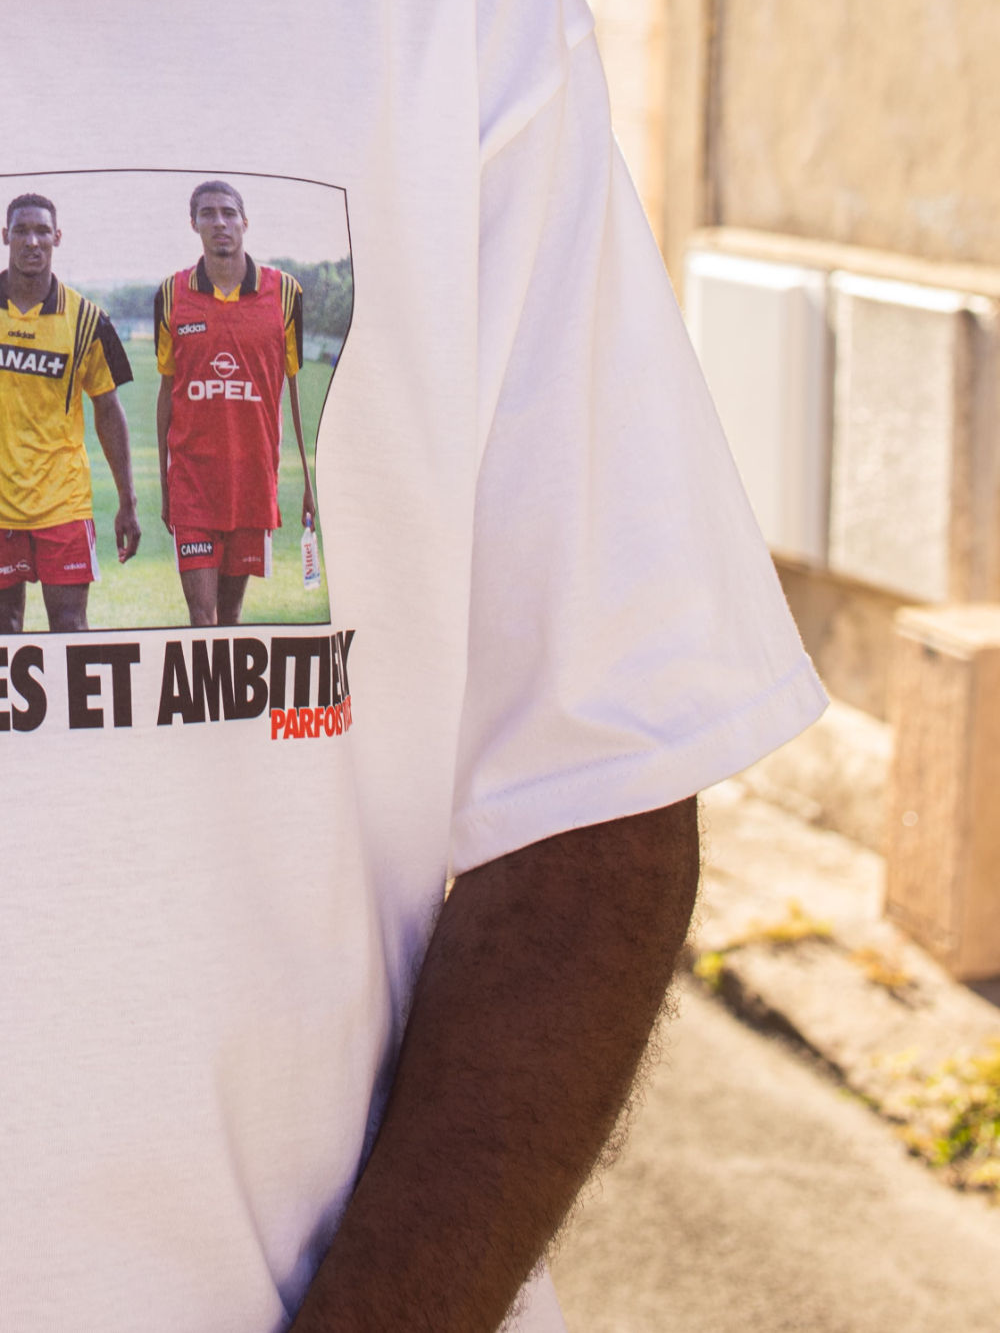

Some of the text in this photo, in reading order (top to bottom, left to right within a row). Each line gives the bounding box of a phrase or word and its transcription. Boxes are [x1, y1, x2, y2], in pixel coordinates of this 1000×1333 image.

[8, 329, 36, 340] adidas
[177, 322, 206, 335] adidas
[187, 379, 262, 402] OPEL
[180, 543, 213, 556] CANAL+
[65, 641, 142, 730] ET
